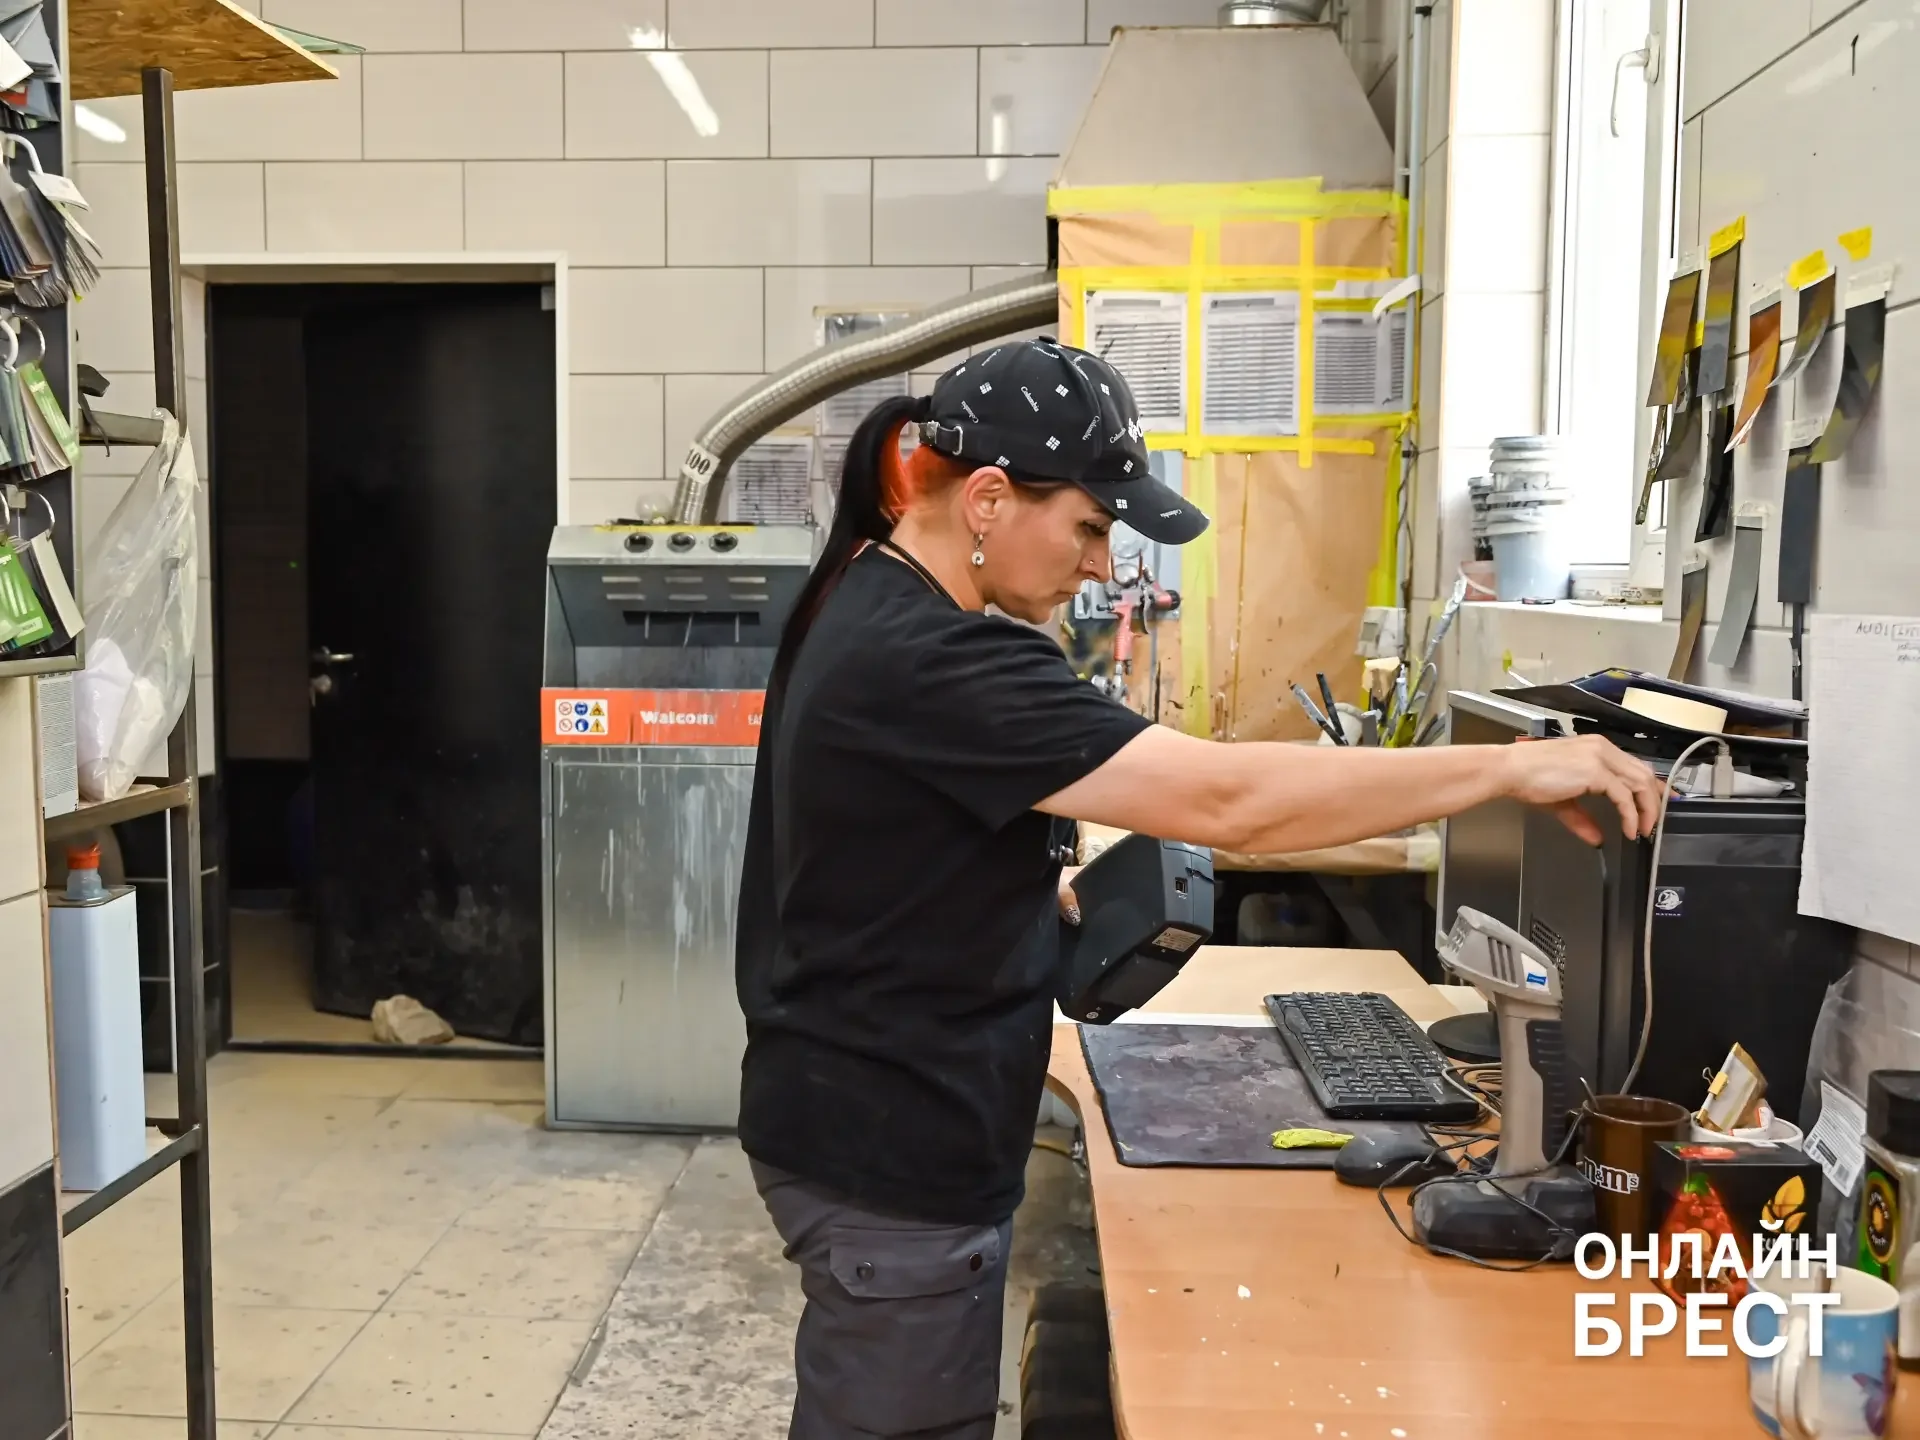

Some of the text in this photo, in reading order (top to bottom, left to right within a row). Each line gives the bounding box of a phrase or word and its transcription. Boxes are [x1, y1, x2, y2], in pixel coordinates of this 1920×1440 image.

[961, 400, 979, 424] Columbia
[1020, 386, 1039, 412] Columbia
[1082, 415, 1100, 441] Columbia
